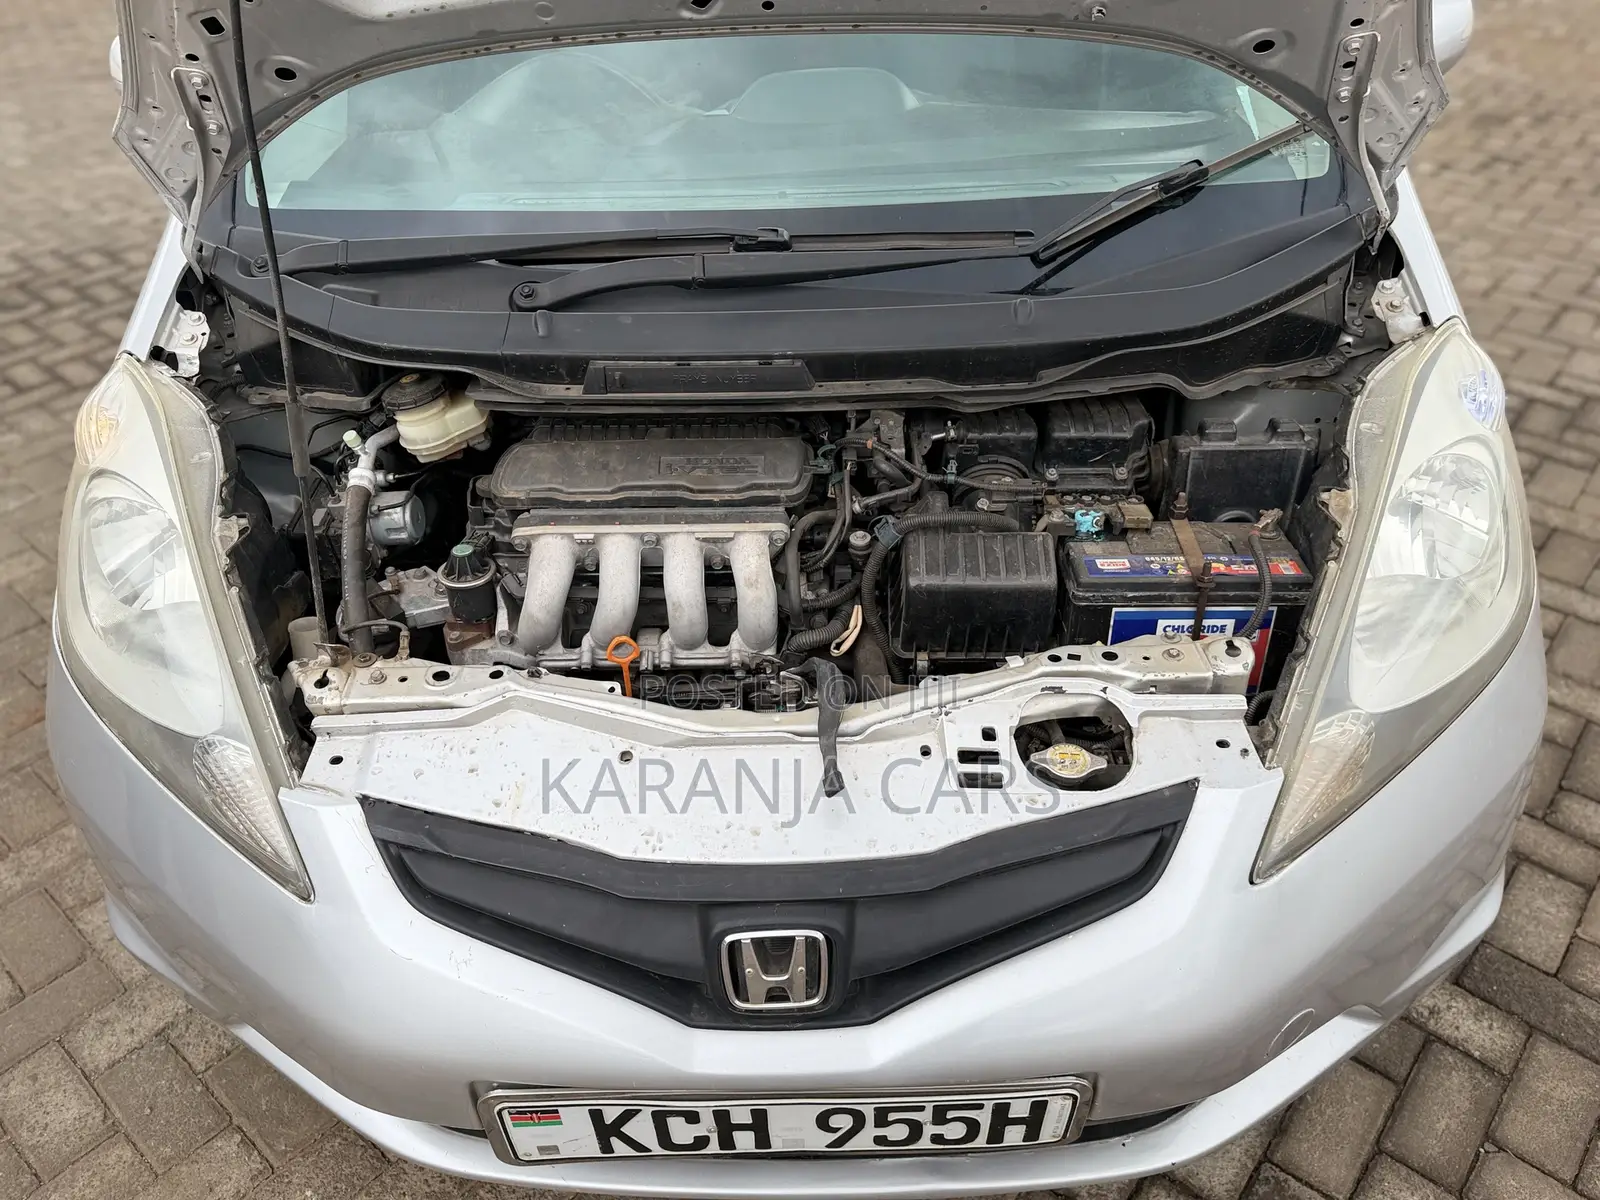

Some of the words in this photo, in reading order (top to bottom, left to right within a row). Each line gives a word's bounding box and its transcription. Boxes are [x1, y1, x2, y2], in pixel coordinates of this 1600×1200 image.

[1163, 624, 1227, 634] CHLORIDE
[587, 1106, 772, 1155] KCH
[815, 1099, 1048, 1149] 955H
